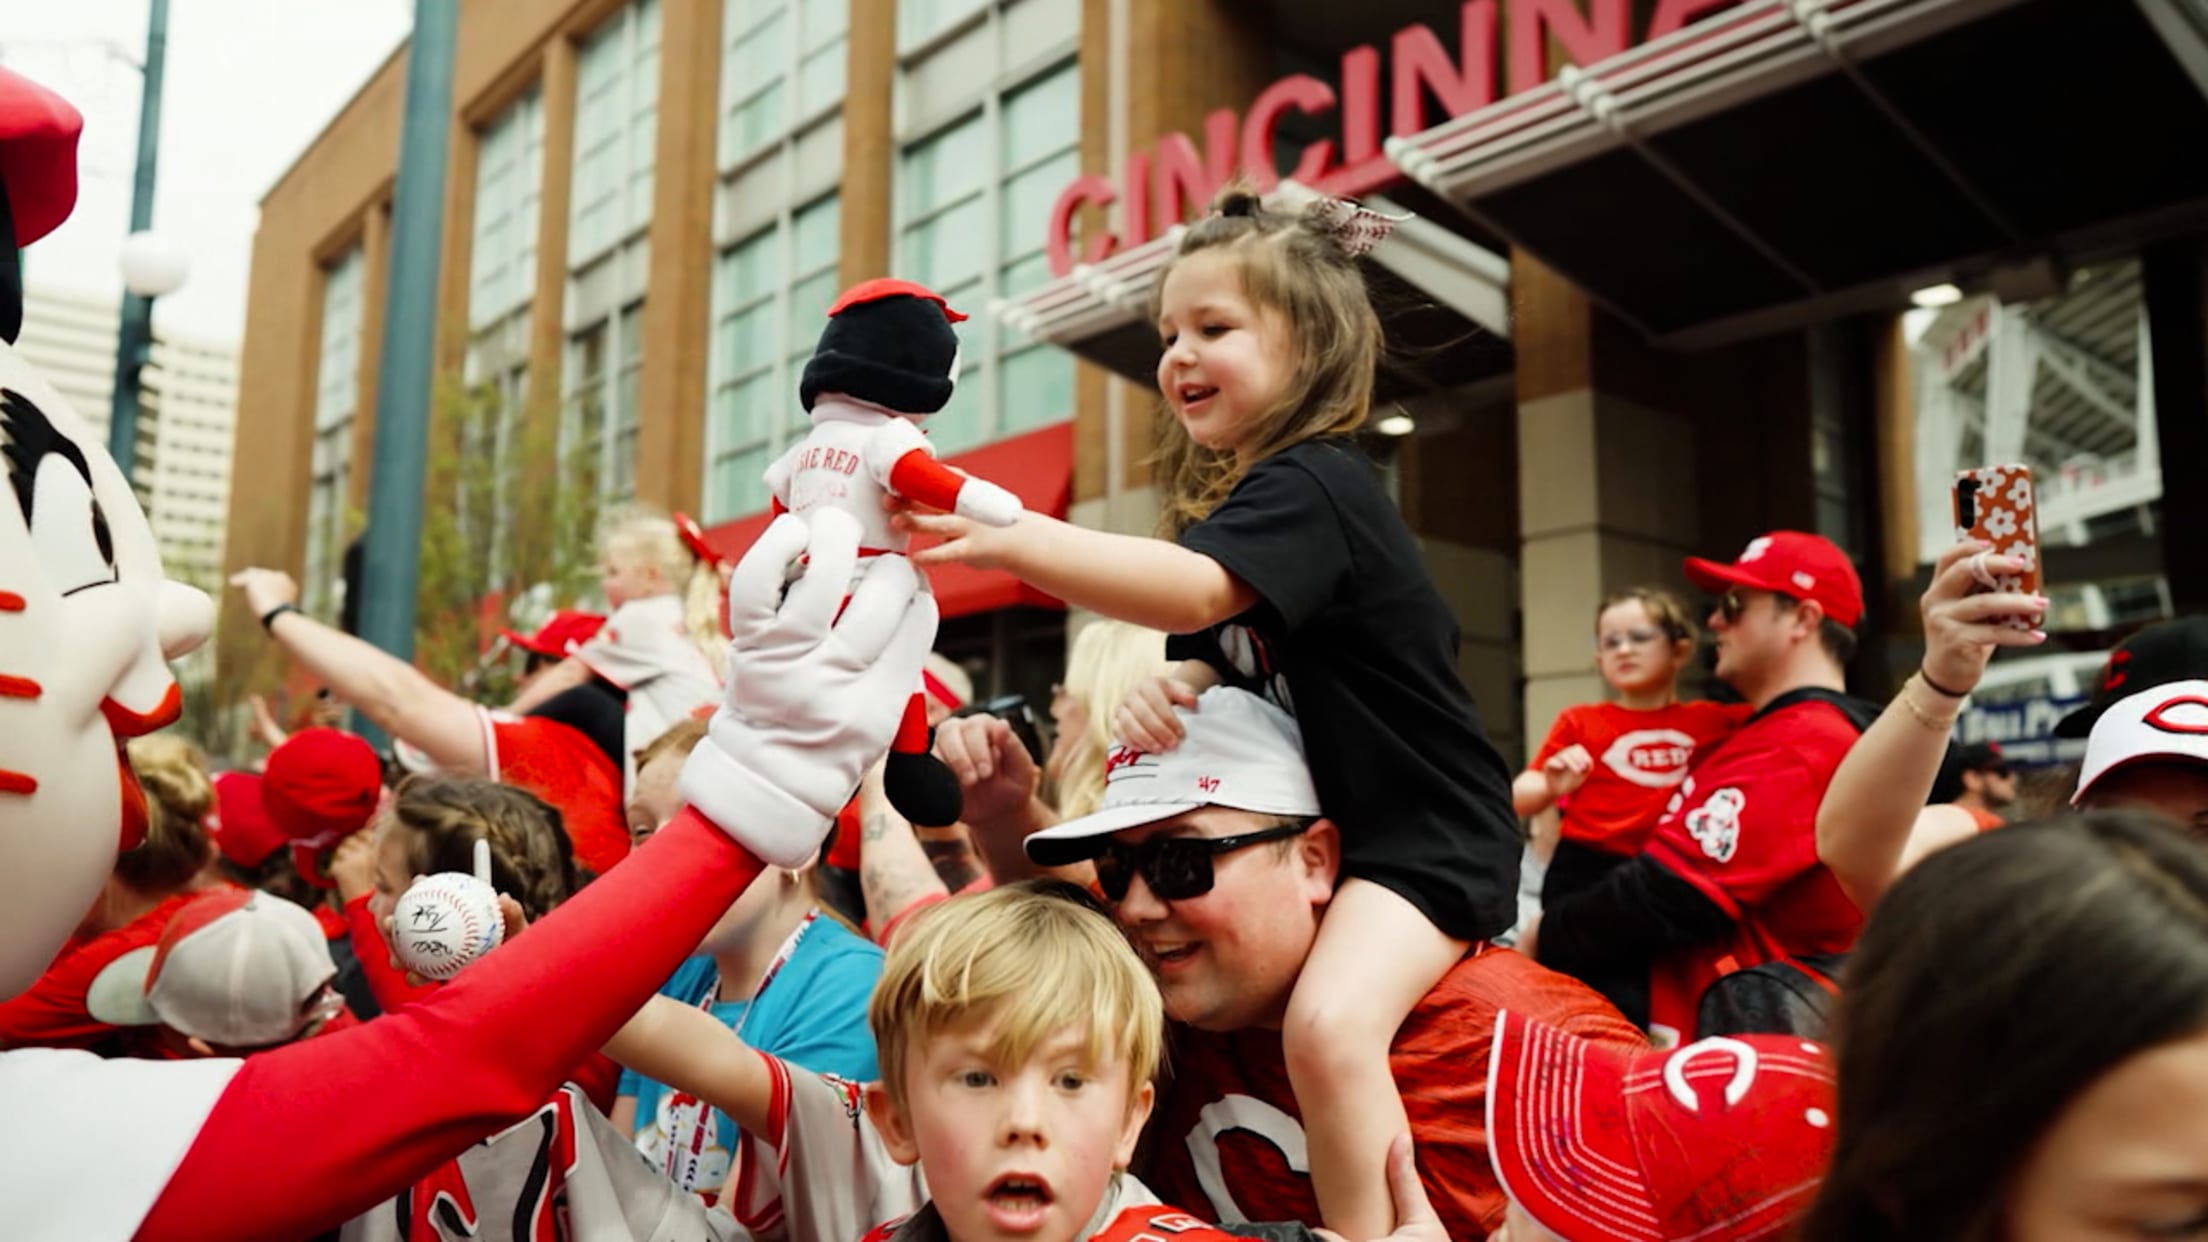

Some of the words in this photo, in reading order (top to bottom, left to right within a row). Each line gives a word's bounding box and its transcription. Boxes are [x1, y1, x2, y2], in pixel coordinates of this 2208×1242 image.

[821, 447, 860, 476] RED
[1631, 746, 1694, 768] RED
[1664, 1036, 1758, 1112] C
